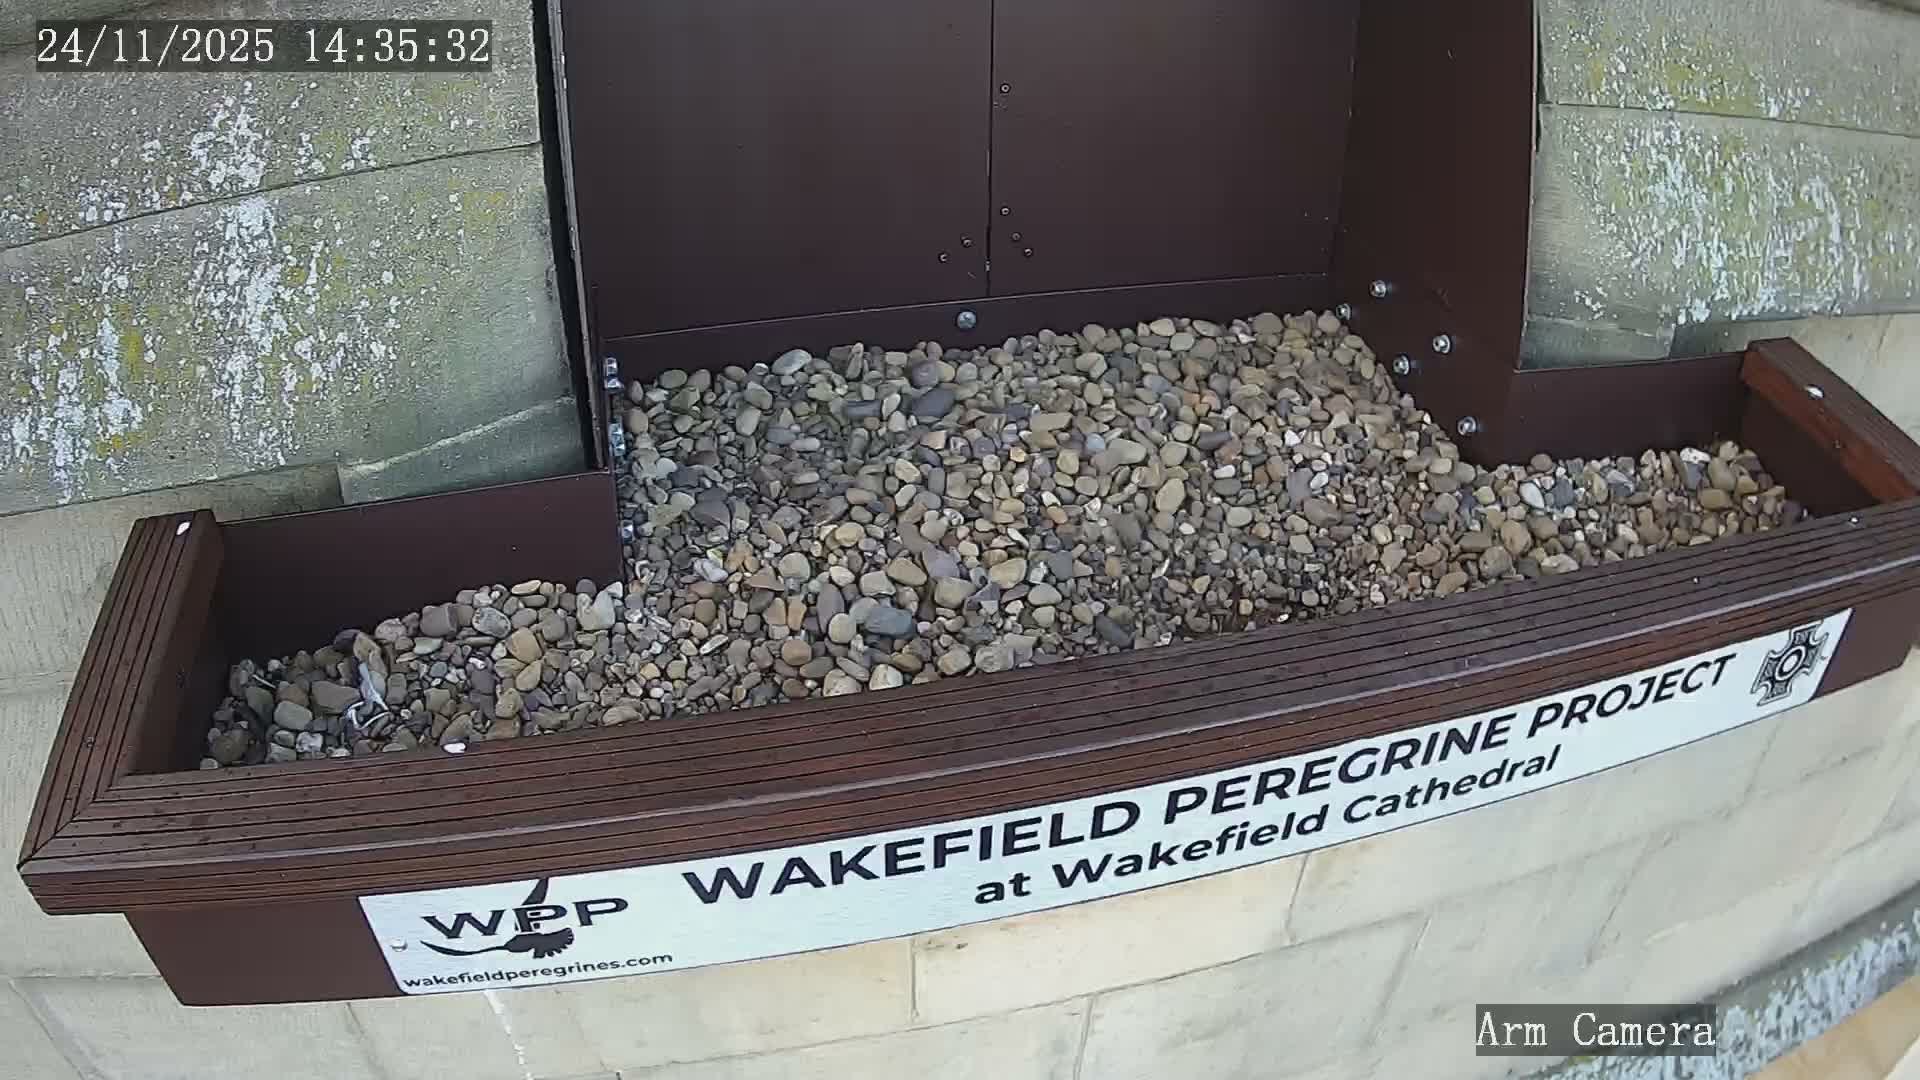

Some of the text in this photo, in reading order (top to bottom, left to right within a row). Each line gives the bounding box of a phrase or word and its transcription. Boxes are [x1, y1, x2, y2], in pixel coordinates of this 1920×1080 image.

[682, 652, 1738, 905] WAKEFIELD PEREGRINE PROJECT
[974, 744, 1562, 905] at Wakefield Cathedral
[420, 897, 629, 940] WPP
[403, 953, 673, 988] wakefieldperegrines.com
